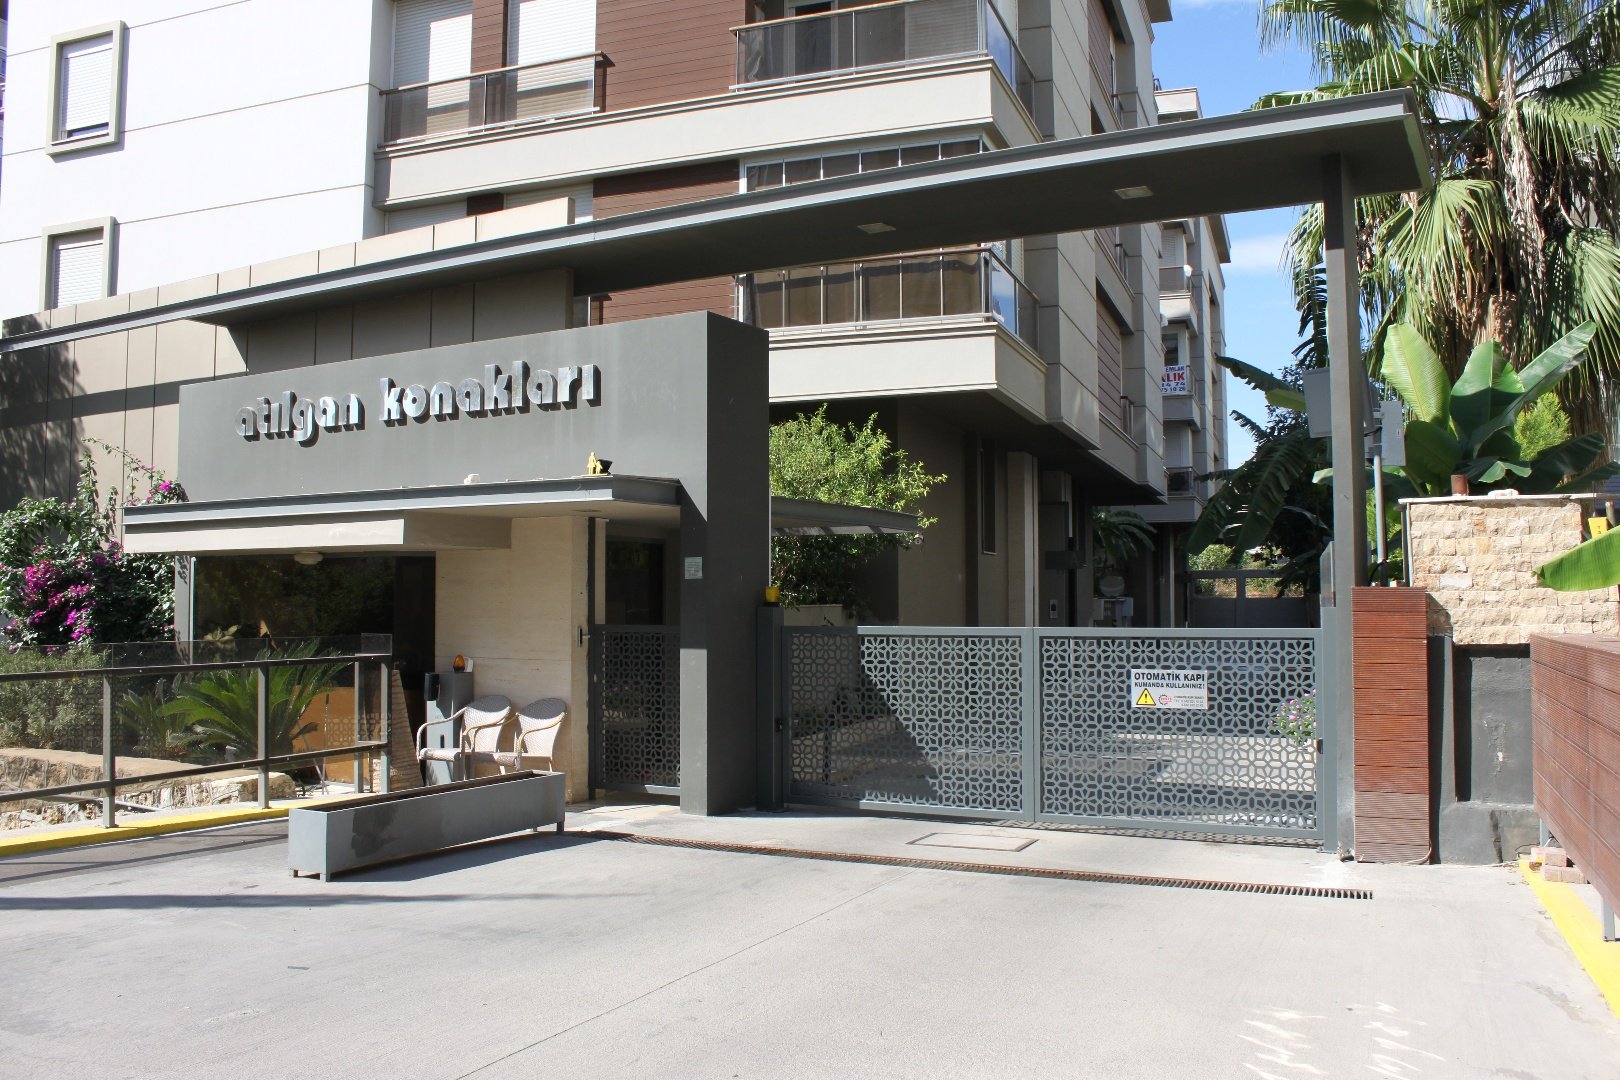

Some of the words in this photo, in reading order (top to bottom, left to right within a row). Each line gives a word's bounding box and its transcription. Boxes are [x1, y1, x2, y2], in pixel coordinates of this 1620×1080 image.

[235, 390, 363, 444] atılgan
[379, 360, 598, 423] konakları
[1134, 671, 1181, 682] OTOMATİK
[1183, 673, 1205, 682] KAPI
